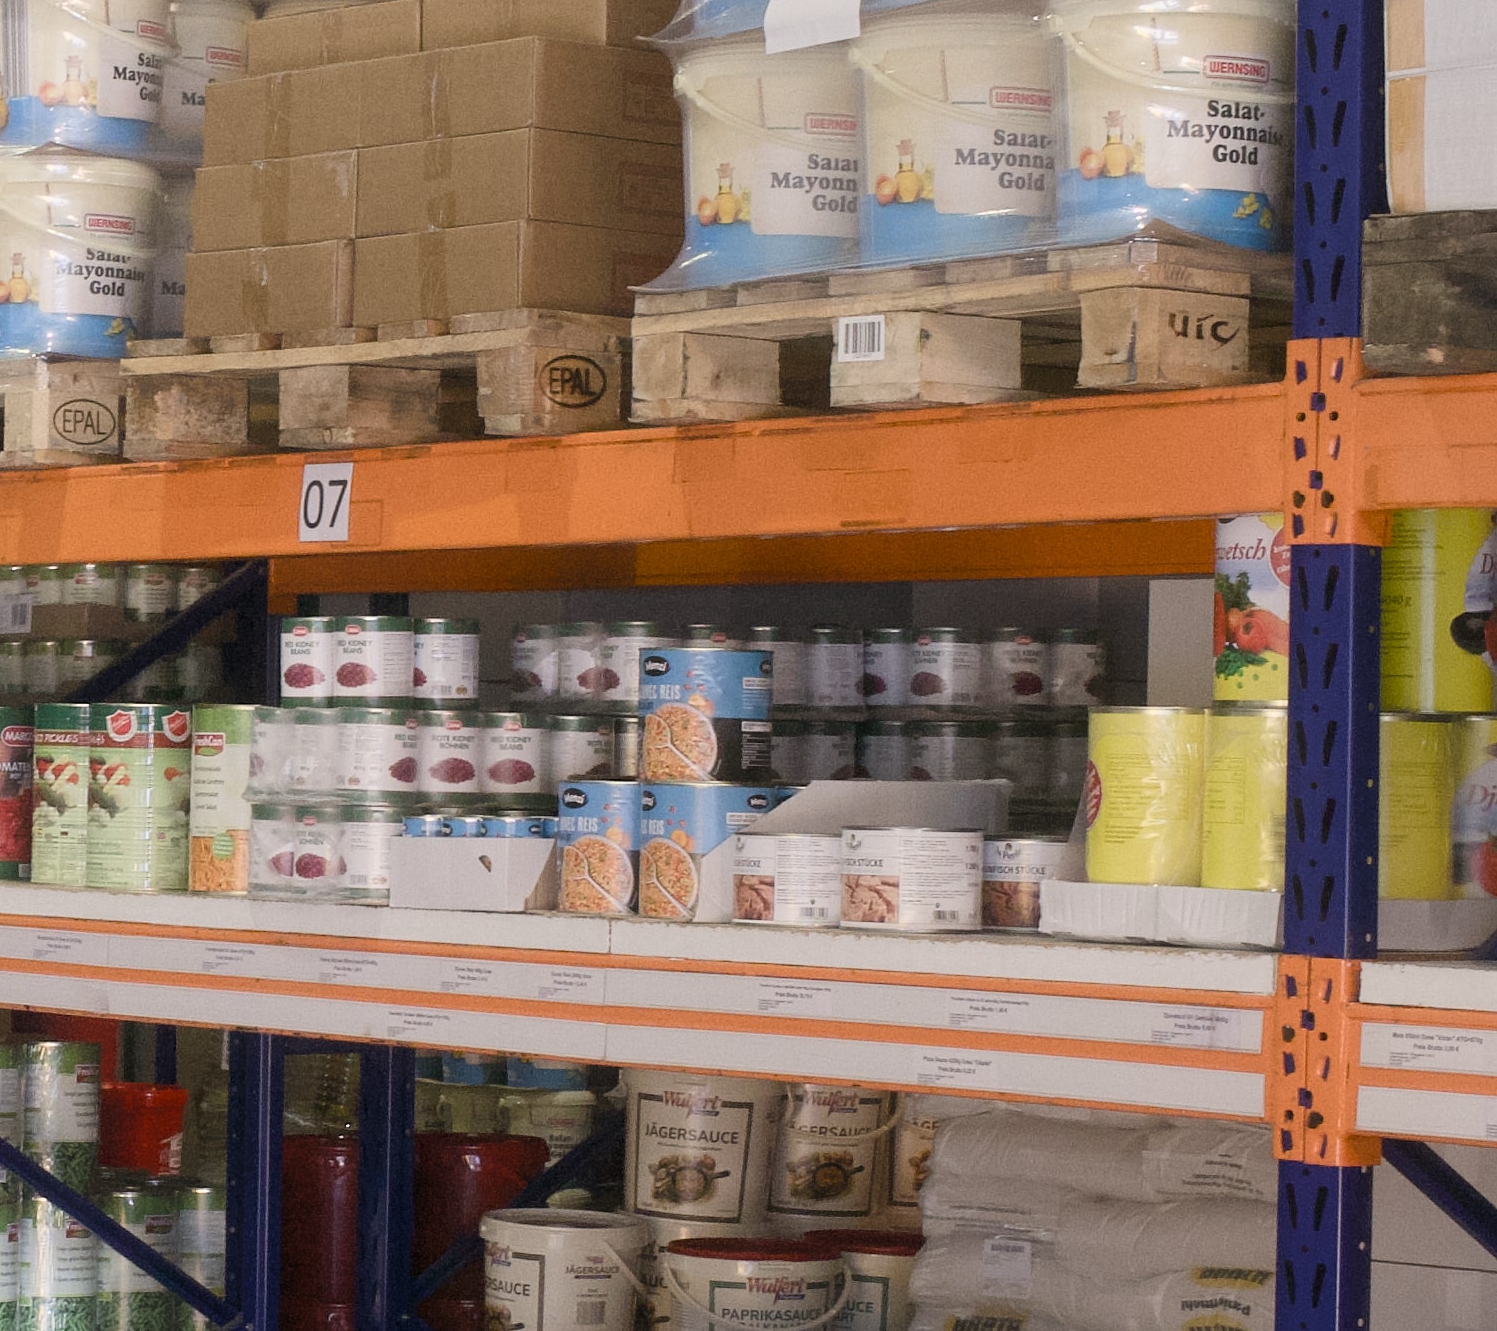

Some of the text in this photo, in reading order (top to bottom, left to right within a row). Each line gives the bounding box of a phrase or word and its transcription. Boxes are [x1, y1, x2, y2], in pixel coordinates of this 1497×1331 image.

[1209, 58, 1267, 78] WERNSING
[1207, 100, 1266, 121] Salat-
[1211, 143, 1259, 167] Gold
[998, 171, 1045, 192] Gold
[89, 280, 126, 298] Gold
[548, 367, 596, 397] EPAL
[62, 409, 107, 437] EPAL
[303, 478, 348, 530] 07
[645, 1123, 740, 1145] JÄGERSAUCE
